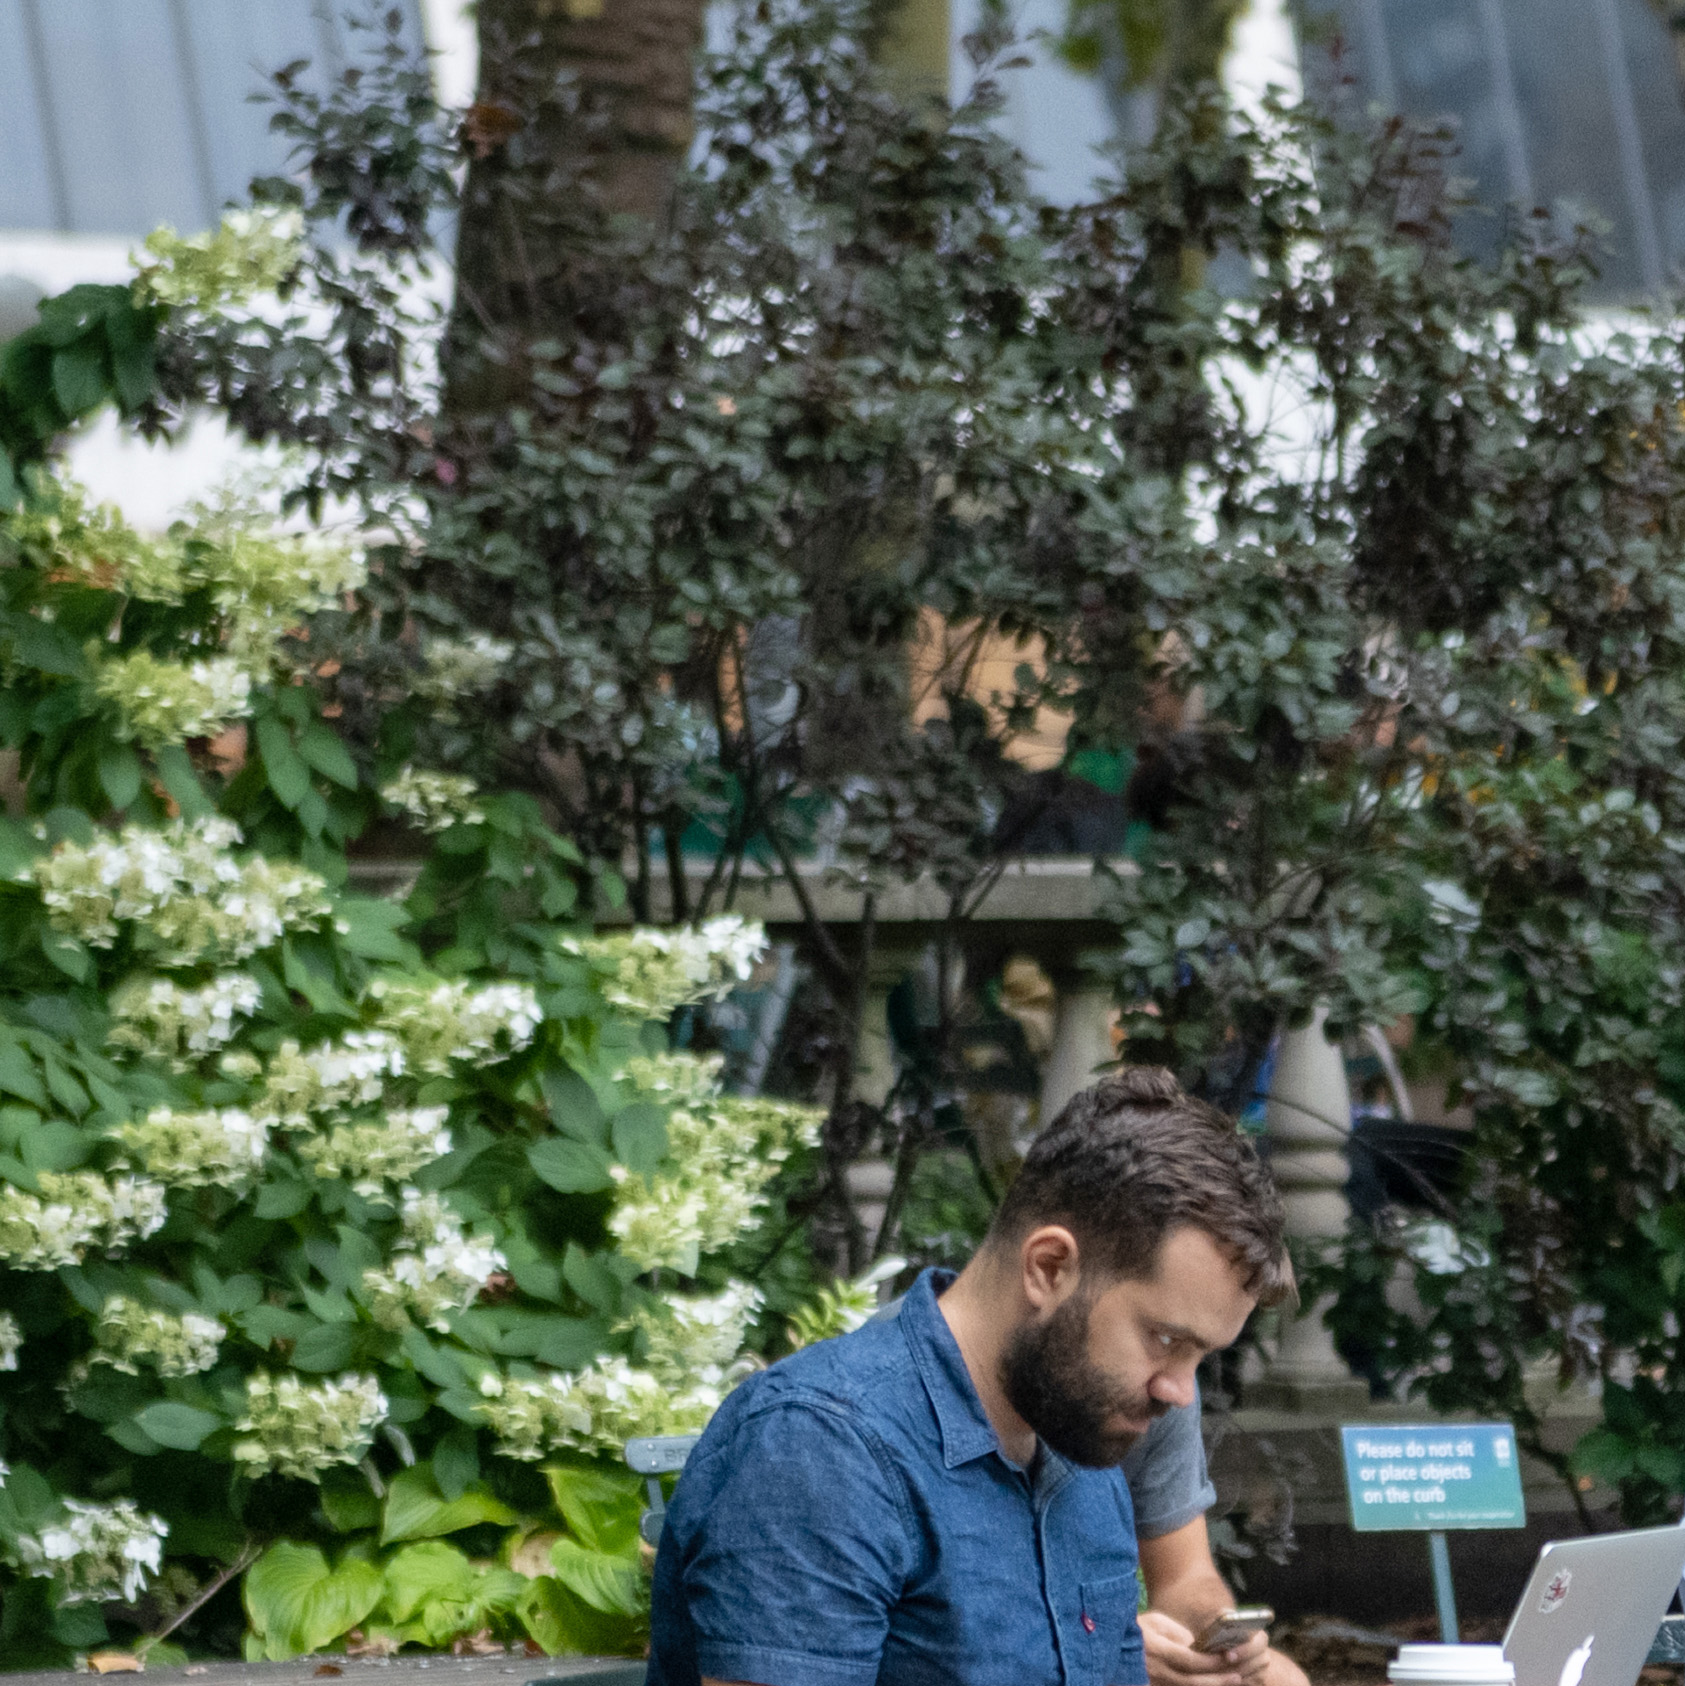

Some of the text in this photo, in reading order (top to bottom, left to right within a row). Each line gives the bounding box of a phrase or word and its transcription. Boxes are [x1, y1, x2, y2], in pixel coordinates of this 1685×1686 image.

[1356, 1440, 1475, 1458] Please do not sit
[1360, 1463, 1472, 1484] or place objects
[1363, 1486, 1446, 1504] on the curb
